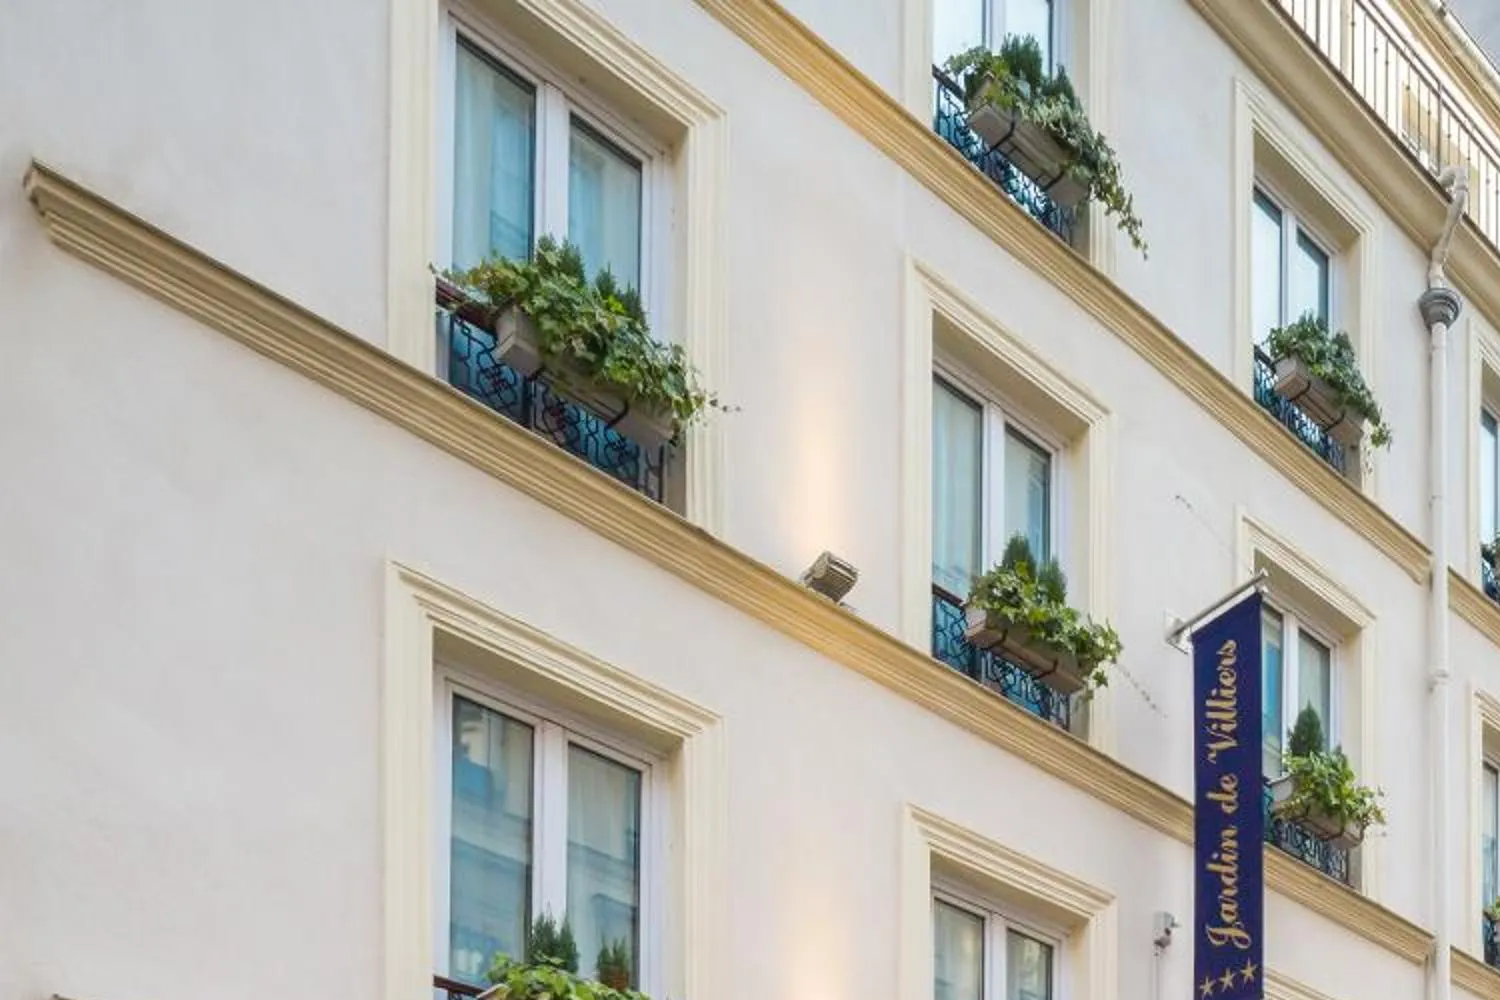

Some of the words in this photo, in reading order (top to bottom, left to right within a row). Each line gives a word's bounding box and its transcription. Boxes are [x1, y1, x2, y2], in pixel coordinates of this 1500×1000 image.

[1205, 639, 1237, 764] Villiers
[1206, 773, 1239, 813] de
[1206, 826, 1251, 948] Jardin
